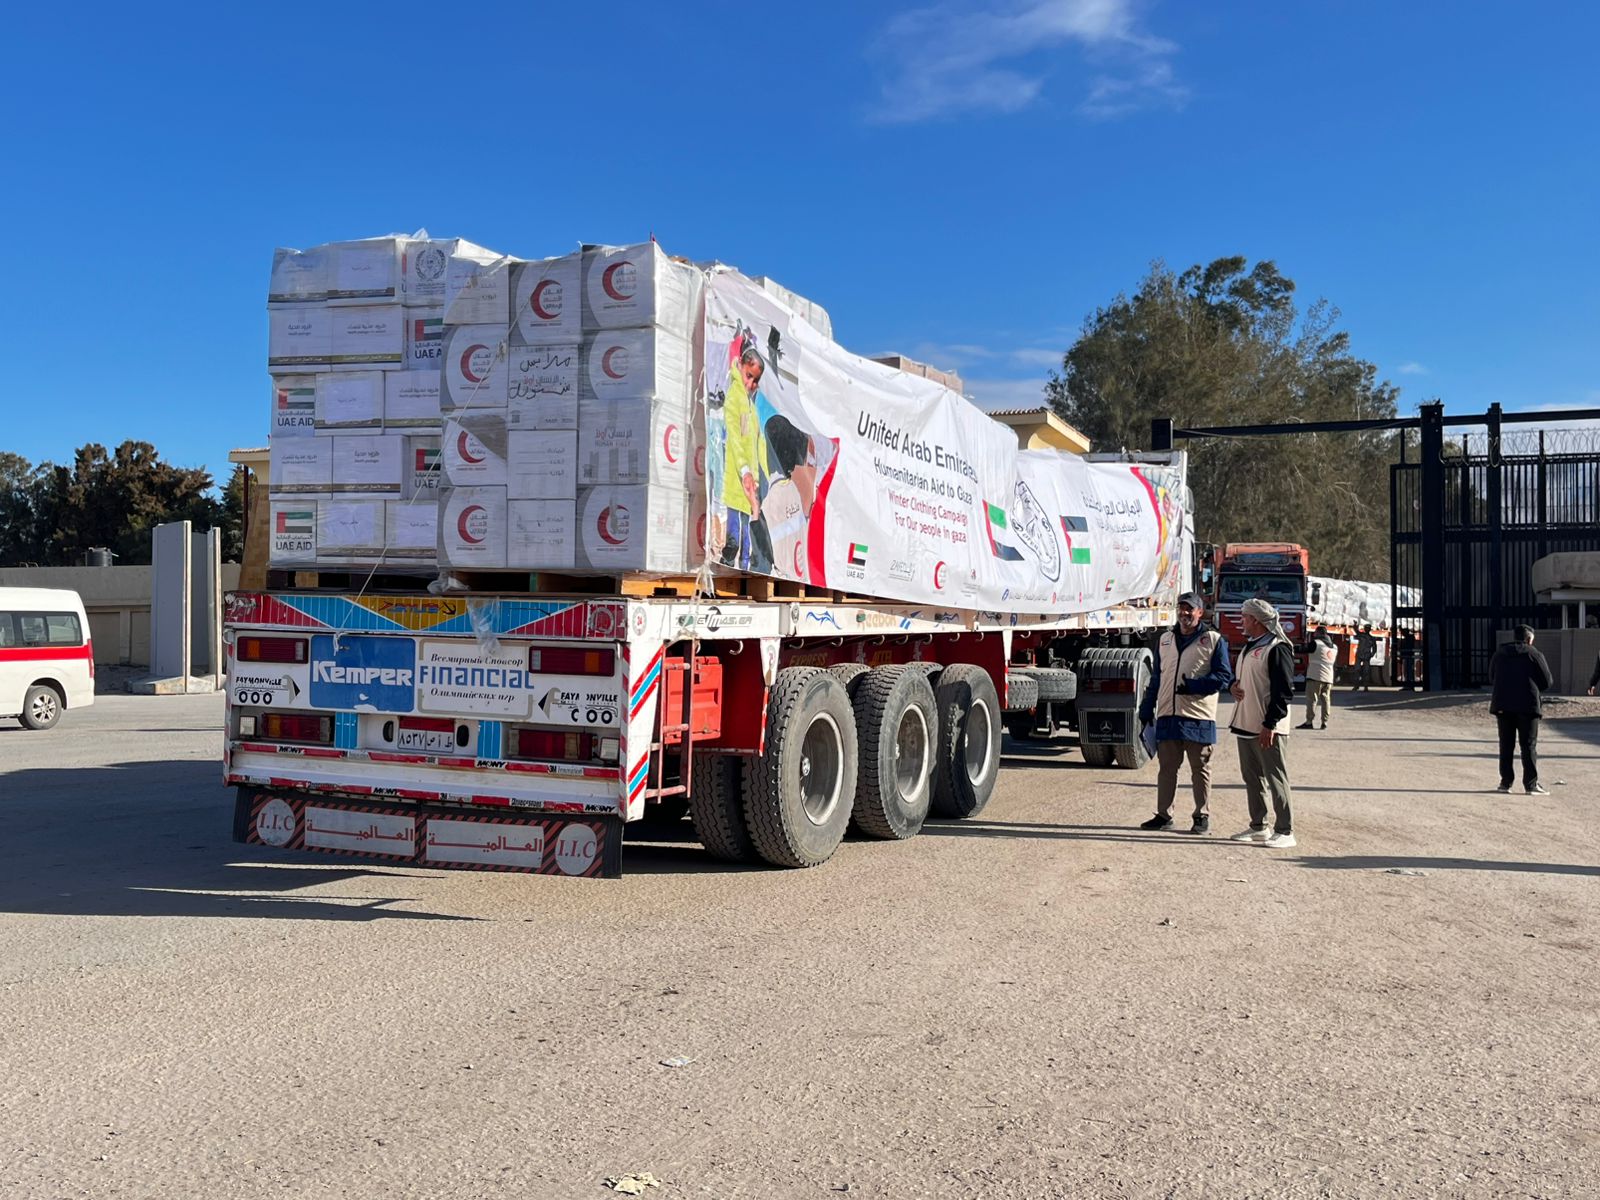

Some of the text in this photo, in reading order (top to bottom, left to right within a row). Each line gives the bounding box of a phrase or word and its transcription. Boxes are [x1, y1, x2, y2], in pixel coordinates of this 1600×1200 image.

[414, 348, 435, 359] UAE
[277, 417, 315, 427] UAE AID
[857, 410, 901, 451] United
[901, 433, 932, 464] Arab
[873, 456, 929, 492] Humanitarian
[930, 477, 945, 496] Aid
[946, 482, 955, 499] to
[887, 487, 909, 509] Winter
[894, 511, 905, 527] For
[905, 515, 918, 531] Our
[942, 525, 951, 539] in
[950, 530, 967, 544] gaza
[275, 541, 313, 551] UAE AID
[306, 819, 414, 842] العالمية
[427, 832, 544, 853] العالمية
